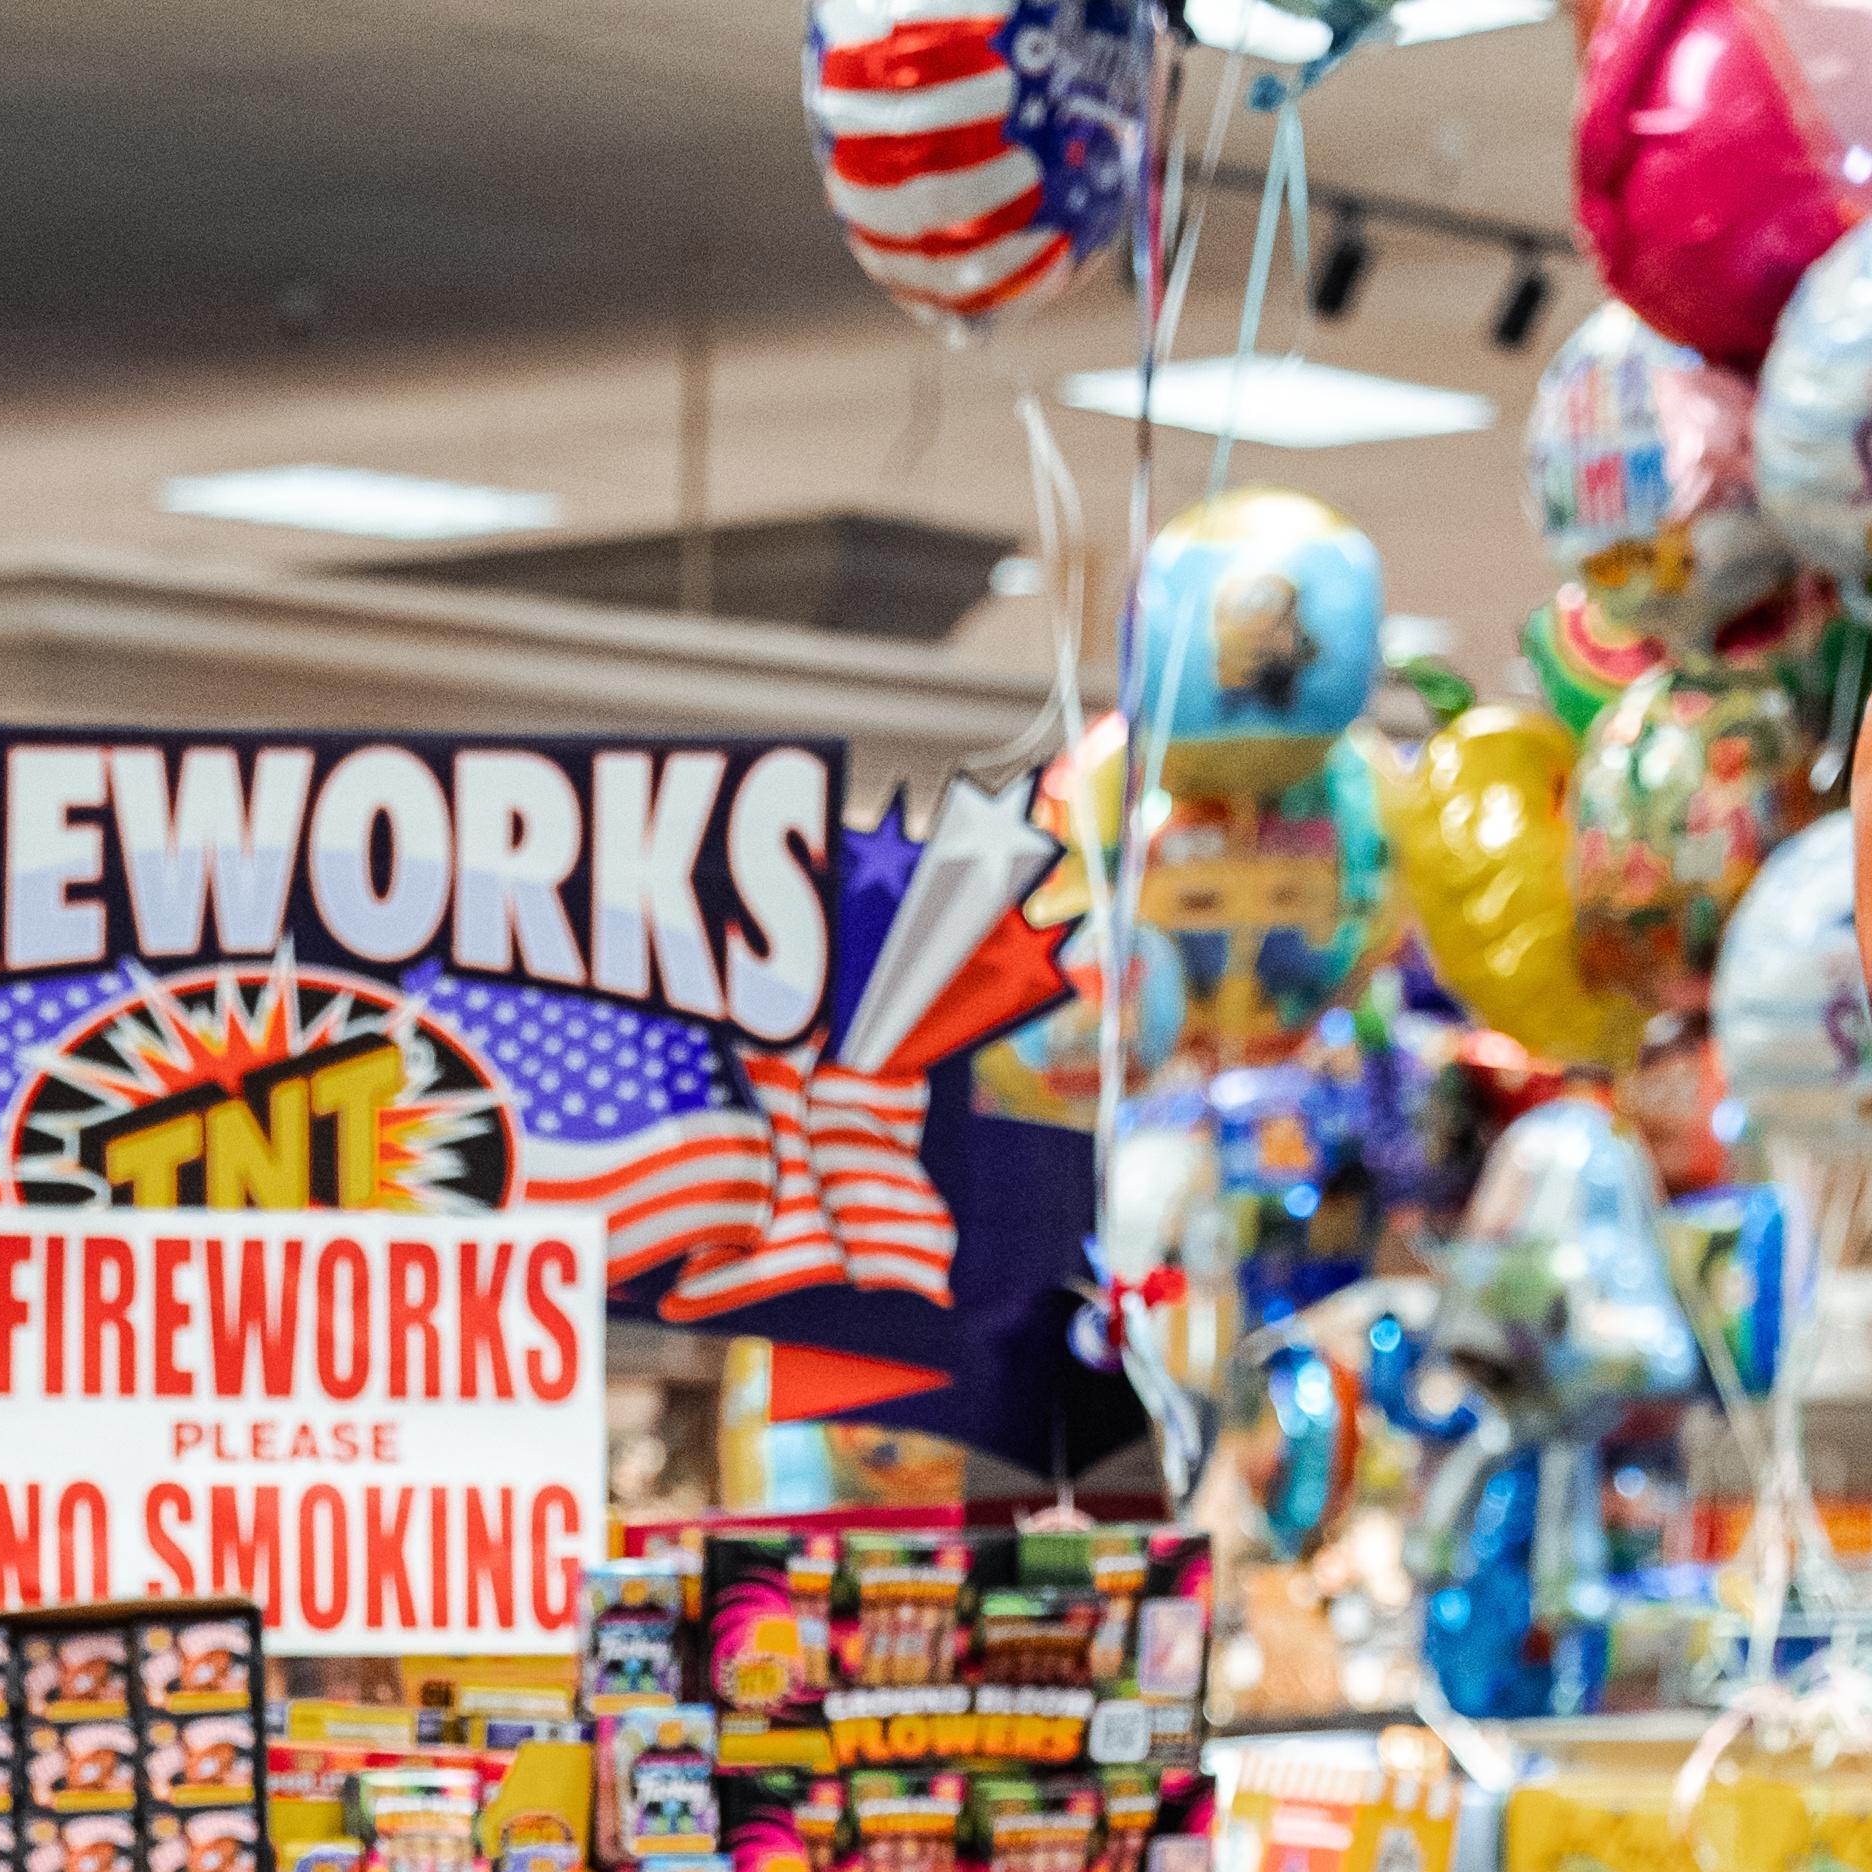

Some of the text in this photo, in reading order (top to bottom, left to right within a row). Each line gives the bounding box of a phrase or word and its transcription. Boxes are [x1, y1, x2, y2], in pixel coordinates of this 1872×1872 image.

[104, 1038, 410, 1208] TNT
[172, 1418, 402, 1465] PLEASE
[143, 1482, 582, 1630] SMOKING
[832, 1713, 1085, 1762] FLOWERS
